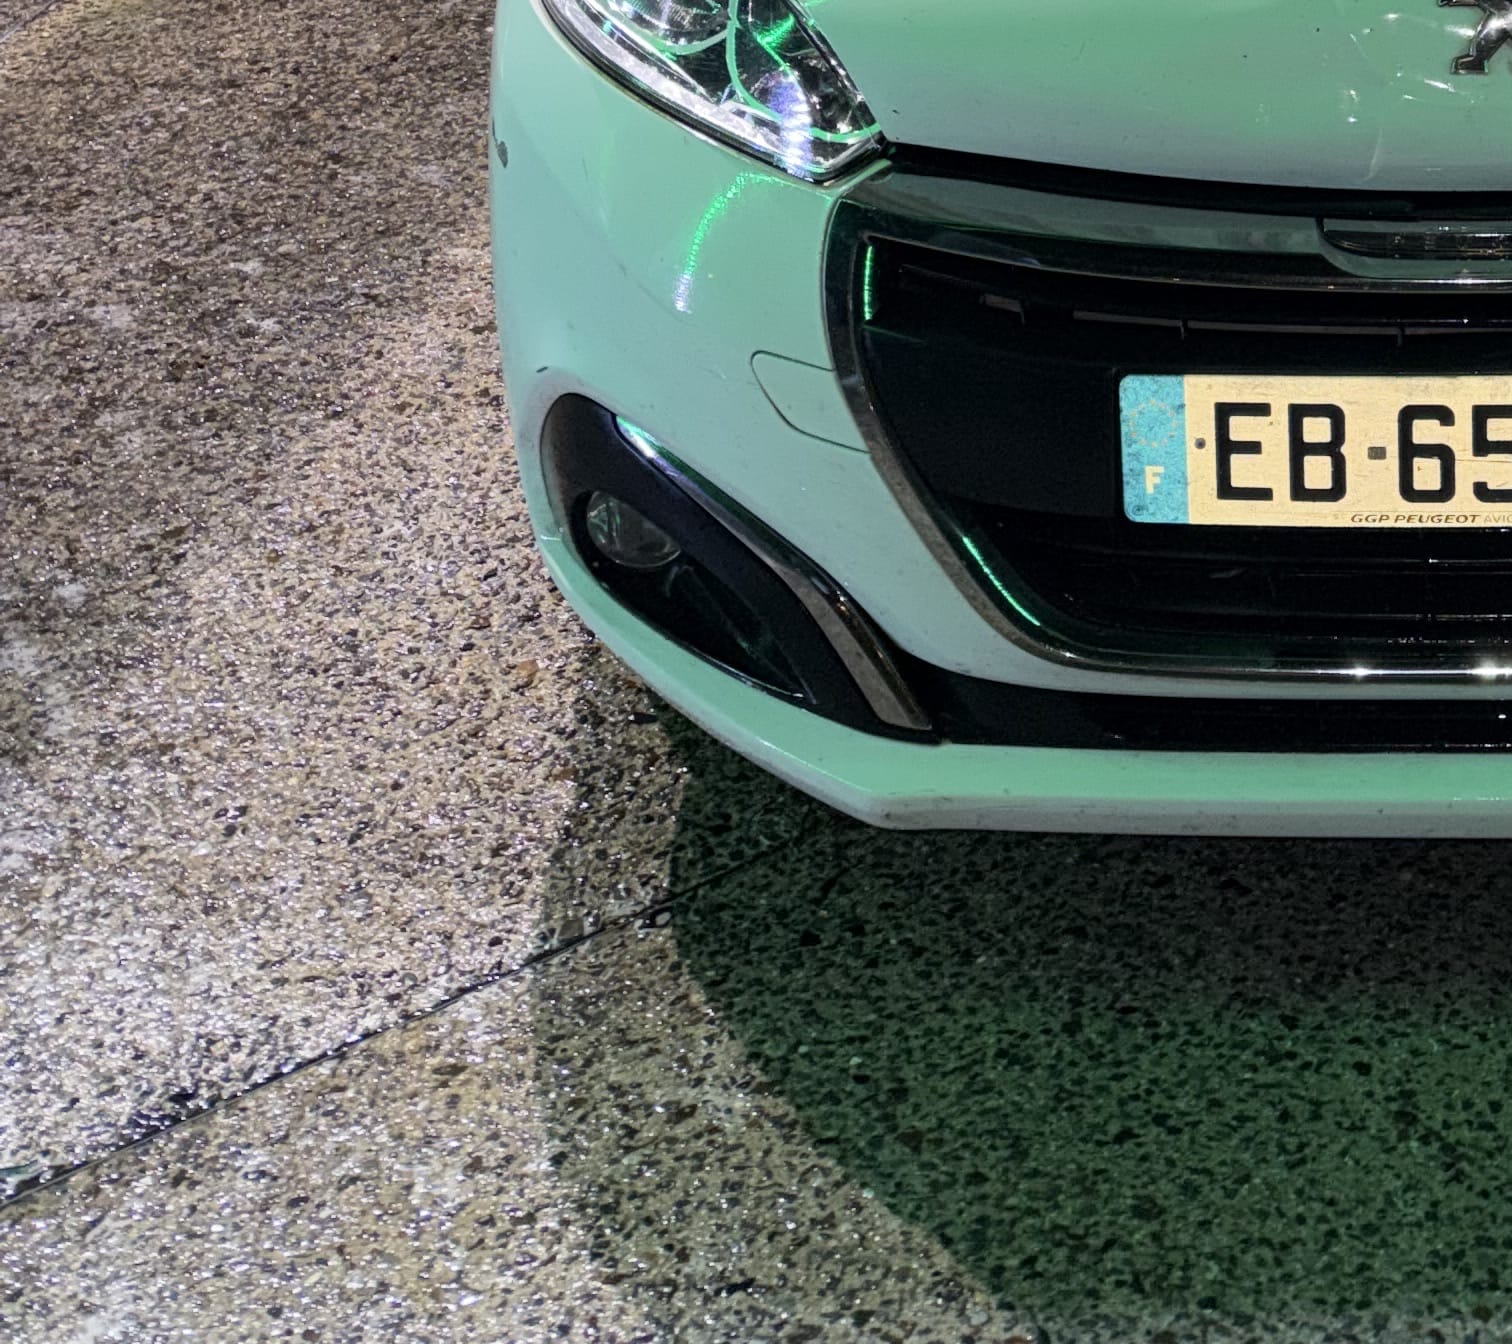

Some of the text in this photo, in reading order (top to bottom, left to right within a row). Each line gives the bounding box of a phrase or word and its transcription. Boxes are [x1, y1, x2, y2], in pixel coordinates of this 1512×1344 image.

[1144, 465, 1165, 494] F
[1350, 513, 1391, 524] GGP
[1394, 513, 1481, 524] PEUGEOT
